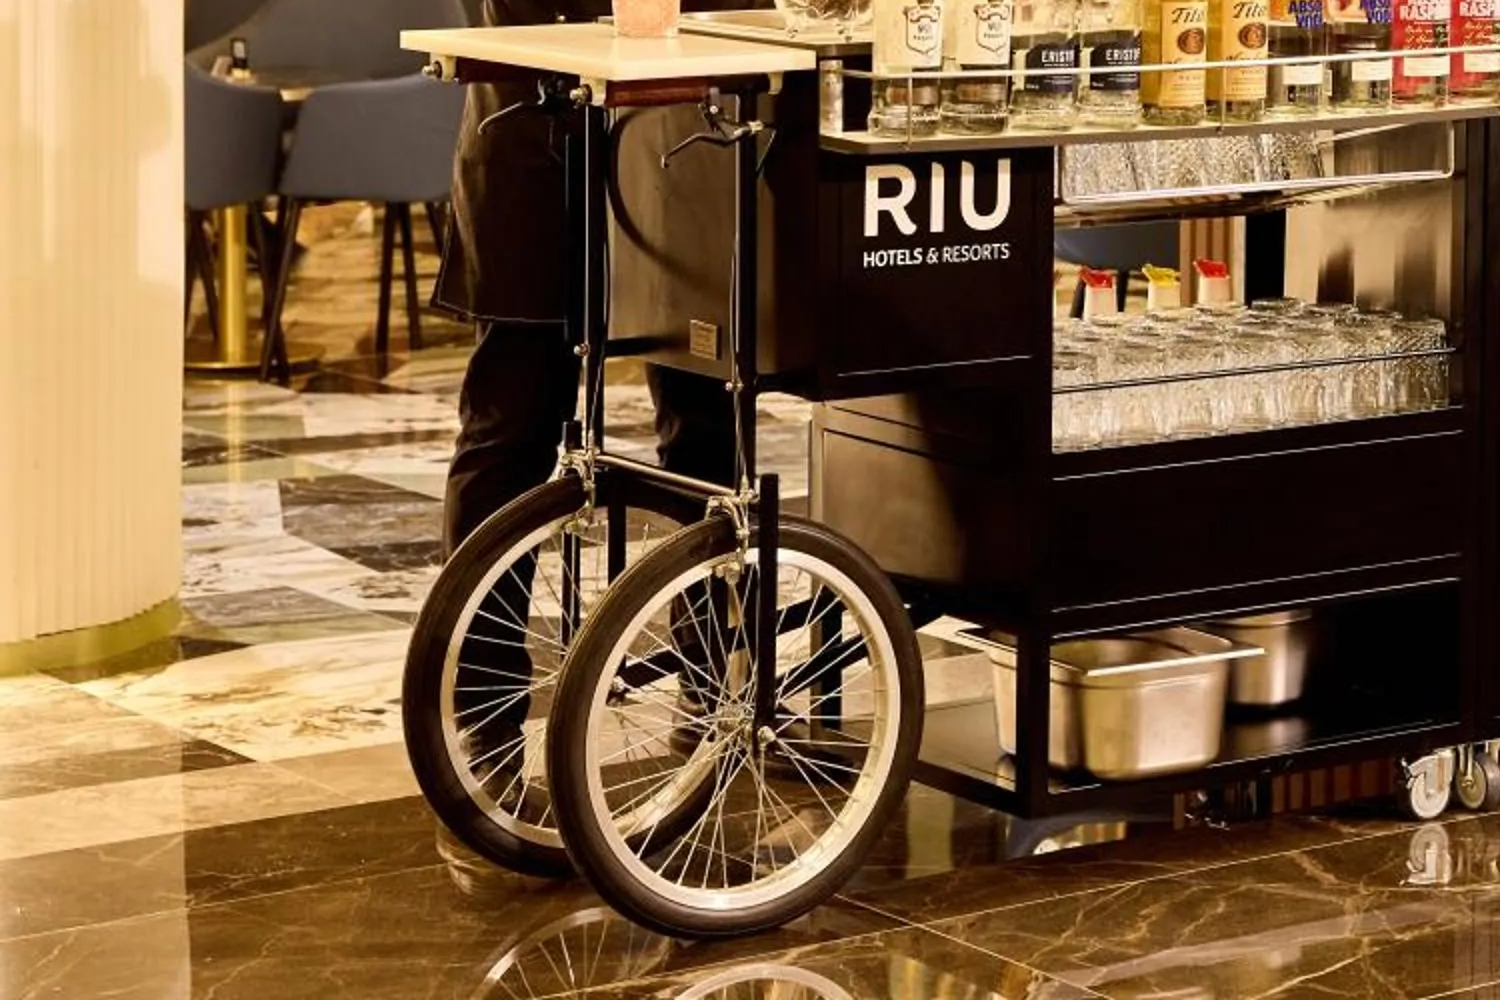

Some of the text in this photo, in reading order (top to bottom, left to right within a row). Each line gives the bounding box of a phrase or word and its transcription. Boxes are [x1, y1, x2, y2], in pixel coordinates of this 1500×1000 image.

[863, 158, 1011, 237] RIU
[863, 242, 1011, 268] HOTELS & RESORTS
